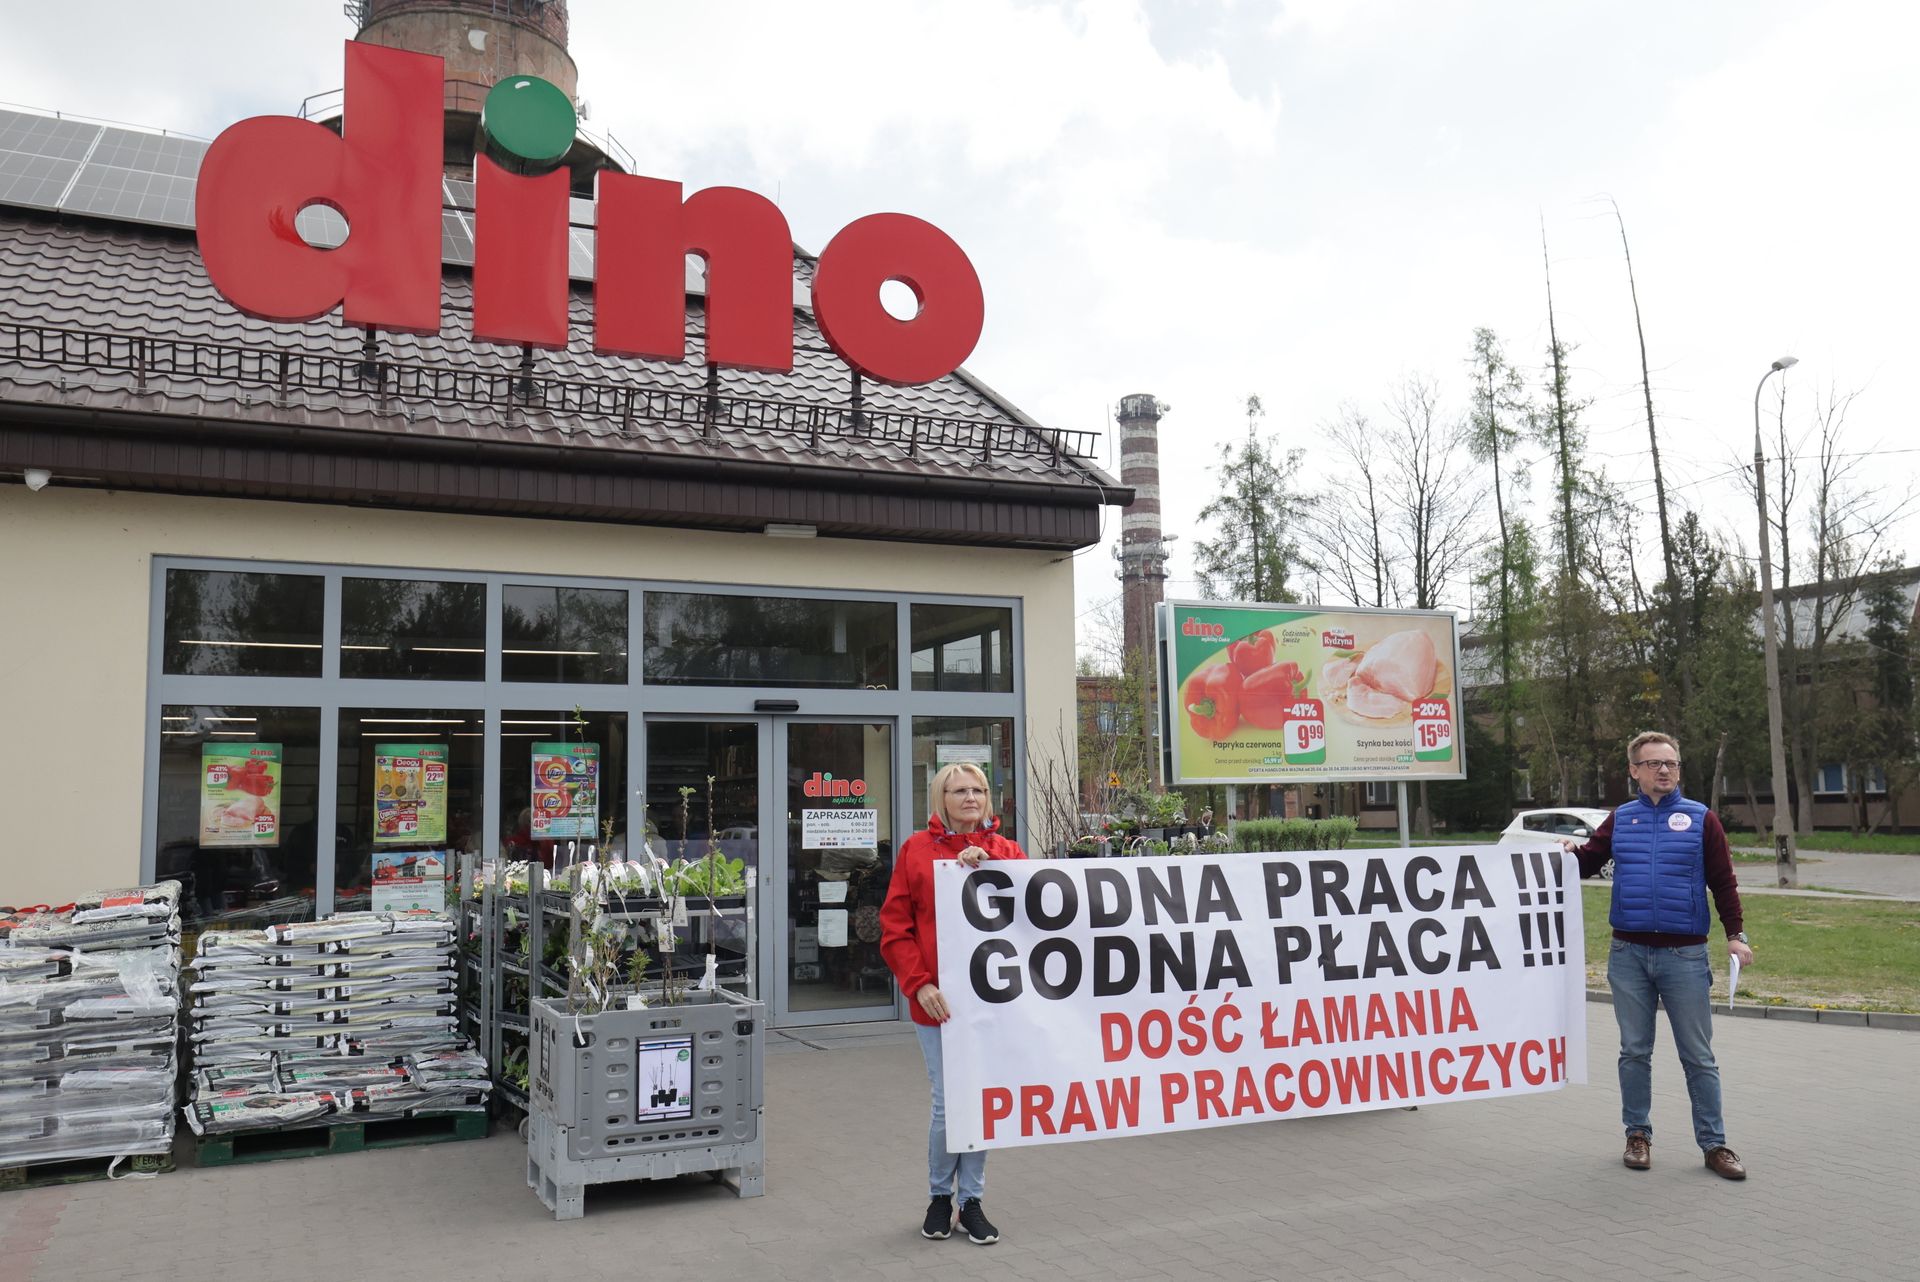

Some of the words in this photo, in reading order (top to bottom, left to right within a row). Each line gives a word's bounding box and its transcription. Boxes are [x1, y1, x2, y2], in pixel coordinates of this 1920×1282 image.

[197, 41, 984, 384] dino
[1182, 617, 1224, 637] dino
[1324, 636, 1353, 647] Rydzyna
[1283, 703, 1318, 717] -41%
[1413, 703, 1446, 717] -20%
[250, 748, 273, 756] dino
[1213, 741, 1244, 750] Papryka
[1245, 741, 1282, 749] czerwona
[1356, 740, 1381, 750] Szynka
[1395, 739, 1413, 747] kości
[803, 772, 867, 797] dino
[806, 811, 874, 820] ZAPRASZAMY
[962, 865, 1243, 932] GODNA
[1263, 854, 1496, 919] PRACA
[1511, 852, 1564, 906] !!!
[969, 929, 1253, 1004] GODNA
[1273, 916, 1502, 985] PŁACA
[1518, 911, 1566, 968] !!!
[1100, 991, 1244, 1063] DOŚĆ
[1260, 987, 1479, 1050] ŁAMANIA
[982, 1077, 1141, 1140] PRAW
[1160, 1036, 1566, 1124] PRACOWNICZYCH
